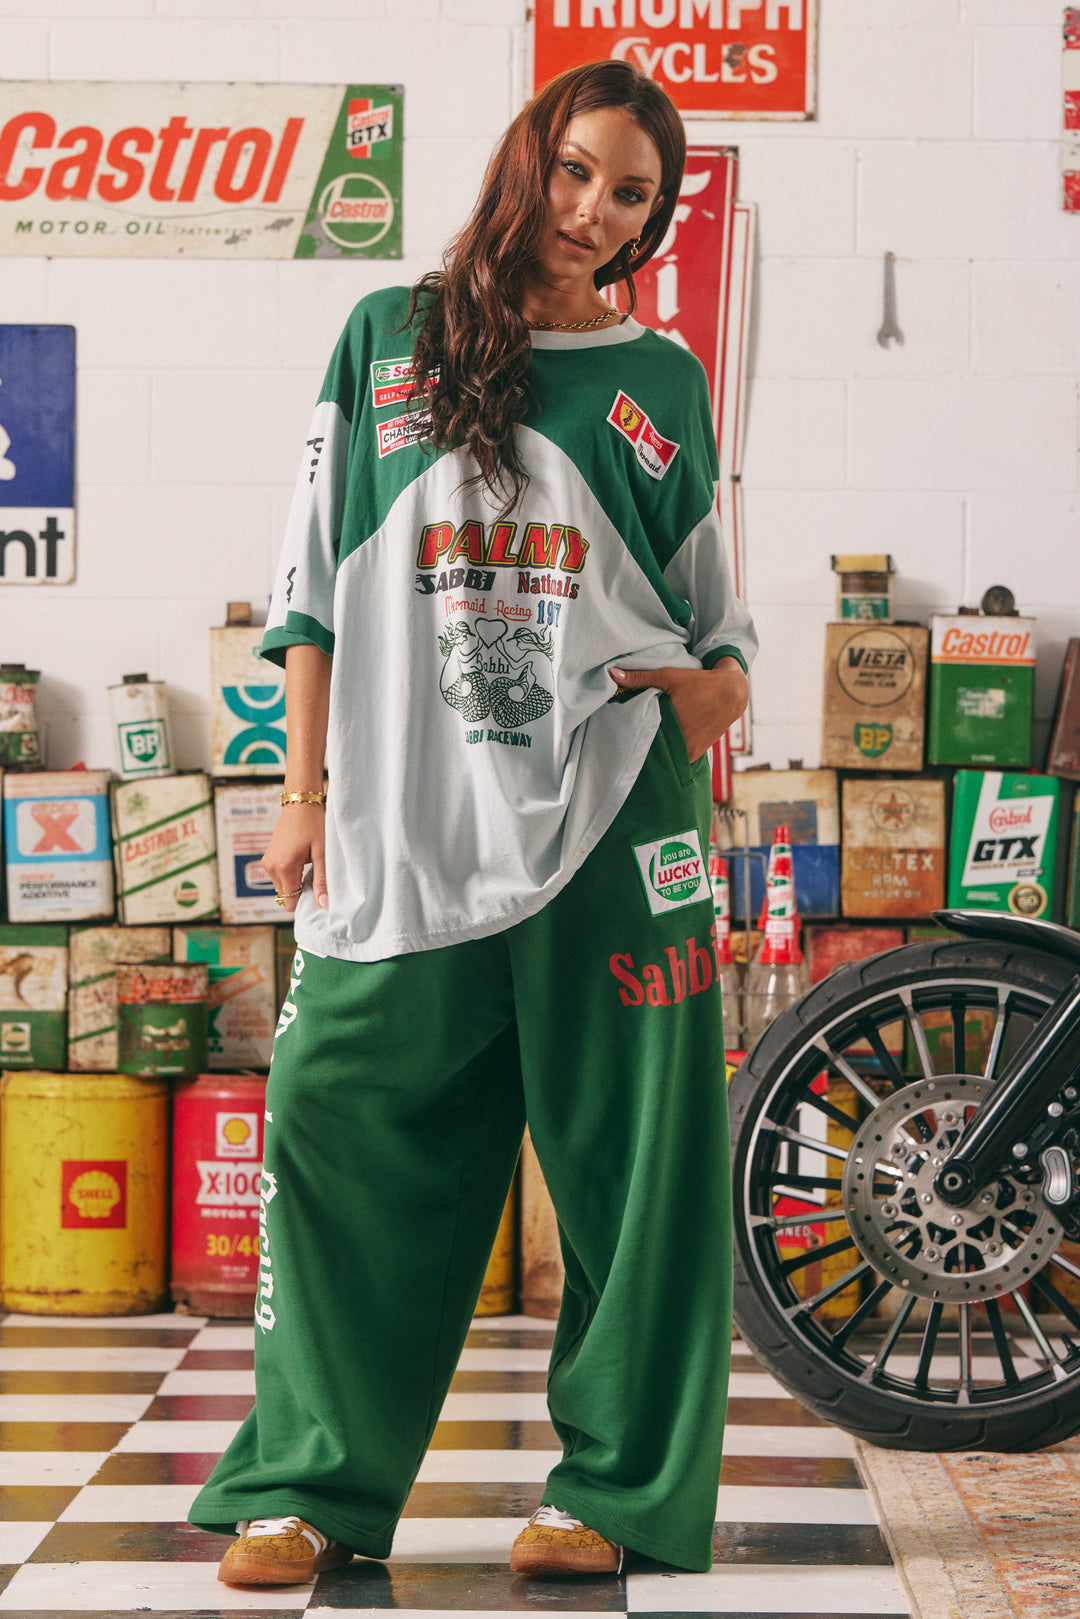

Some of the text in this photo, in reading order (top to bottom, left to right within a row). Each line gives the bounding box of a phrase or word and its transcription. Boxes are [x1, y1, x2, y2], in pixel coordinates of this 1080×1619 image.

[351, 122, 388, 145] GTX
[0, 111, 305, 203] Castrol
[330, 201, 389, 219] Castrol
[15, 220, 107, 235] MOTOR
[126, 220, 166, 235] OIL
[417, 520, 590, 573] PALMY
[415, 567, 496, 595] SABBI
[445, 595, 487, 617] Mermaid
[493, 599, 533, 622] Racing
[941, 628, 1032, 656] Castrol
[470, 652, 511, 675] Sabbi
[848, 647, 905, 668] VICTA
[129, 729, 160, 756] BP
[487, 729, 533, 748] RACEWAY
[858, 727, 891, 751] BP
[989, 805, 1033, 835] Castrol
[662, 847, 692, 865] you are
[973, 835, 1041, 862] GTX
[657, 860, 701, 885] LUCKY
[848, 852, 935, 872] CALTEX
[661, 879, 700, 898] TO BE YOU
[872, 873, 909, 888] RPM
[609, 922, 720, 1007] Sabbi
[77, 1188, 114, 1200] SHELL
